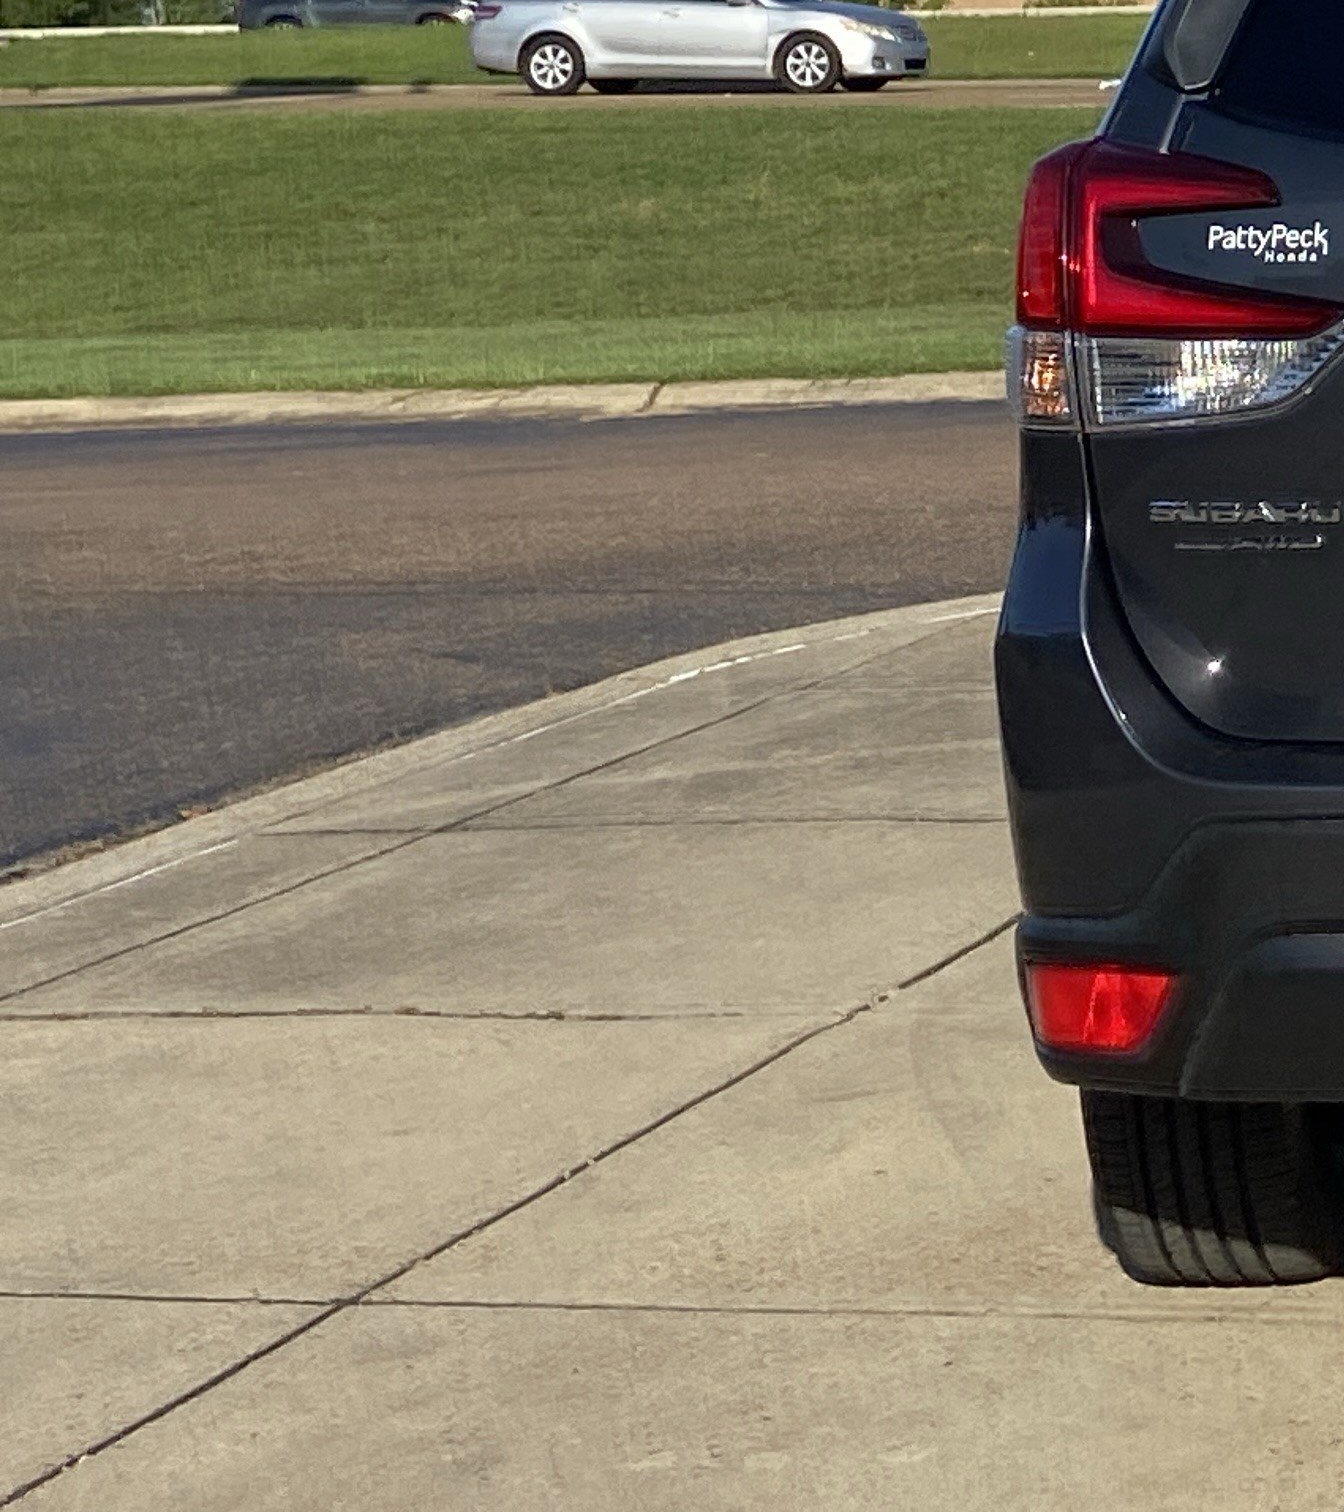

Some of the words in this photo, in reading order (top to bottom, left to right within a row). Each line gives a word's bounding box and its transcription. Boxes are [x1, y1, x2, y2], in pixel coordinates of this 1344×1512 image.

[1208, 220, 1328, 257] PattyPeck
[1264, 251, 1317, 263] Honda
[1149, 500, 1341, 523] SUBARU
